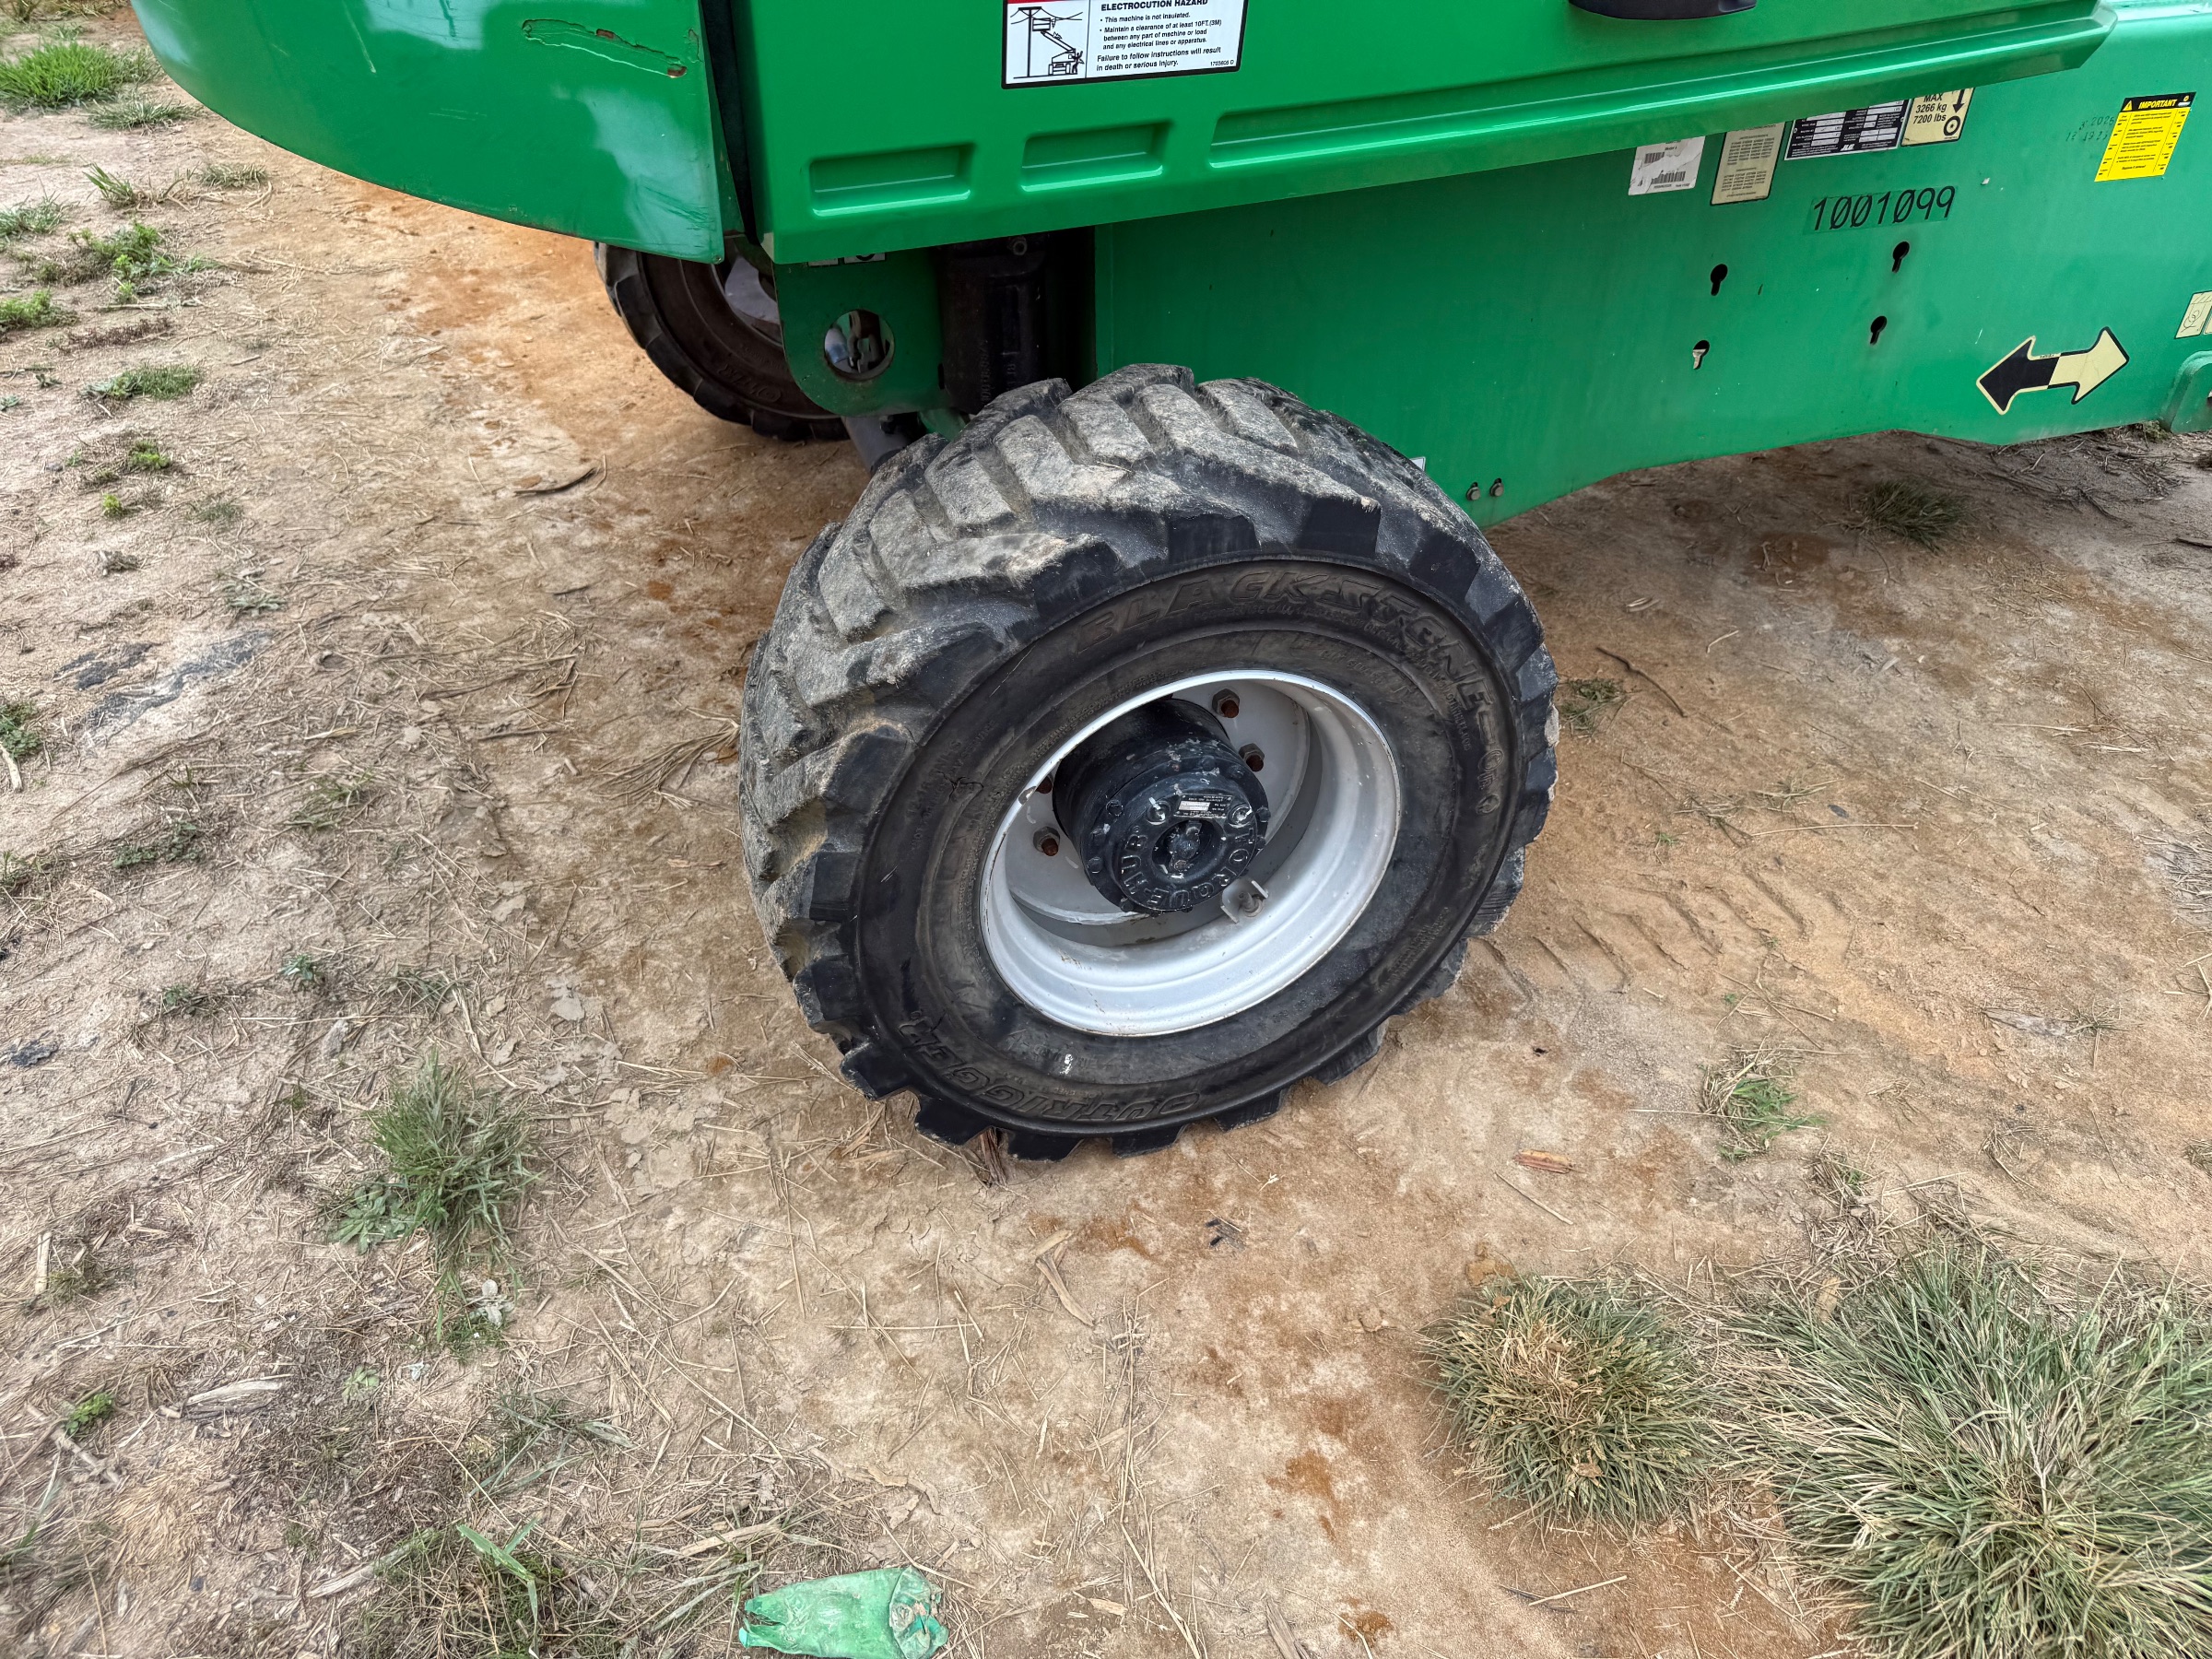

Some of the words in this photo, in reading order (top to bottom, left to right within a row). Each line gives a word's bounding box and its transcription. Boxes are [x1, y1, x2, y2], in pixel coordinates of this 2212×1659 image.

[1101, 0, 1172, 11] ELECTROCUTION
[1151, 50, 1189, 58] instructions
[1159, 59, 1179, 67] injury.
[1924, 93, 1943, 102] MAX
[1916, 103, 1936, 113] 3266
[1936, 102, 1947, 112] kg
[2138, 99, 2178, 110] IMPORTANT
[1913, 114, 1932, 124] 7200
[1934, 113, 1947, 122] lbs
[1814, 185, 1956, 230] 1001099
